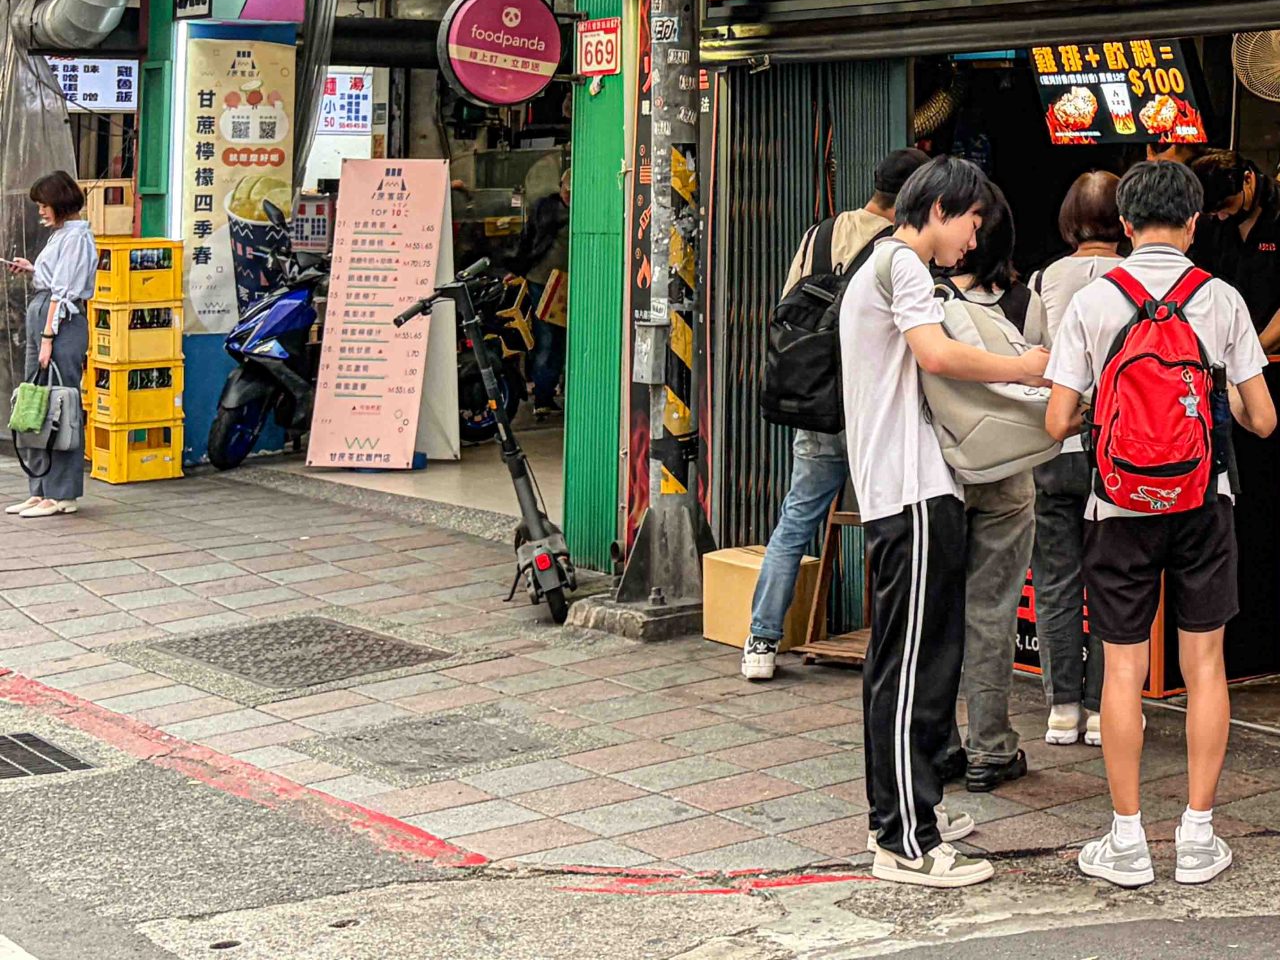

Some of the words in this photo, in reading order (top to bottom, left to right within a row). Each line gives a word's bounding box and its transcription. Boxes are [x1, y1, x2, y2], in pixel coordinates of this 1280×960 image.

[458, 24, 546, 52] foodpanda
[584, 38, 614, 68] 669
[1127, 67, 1185, 97] $100
[192, 89, 216, 266] 甘蔗檸檬四季春
